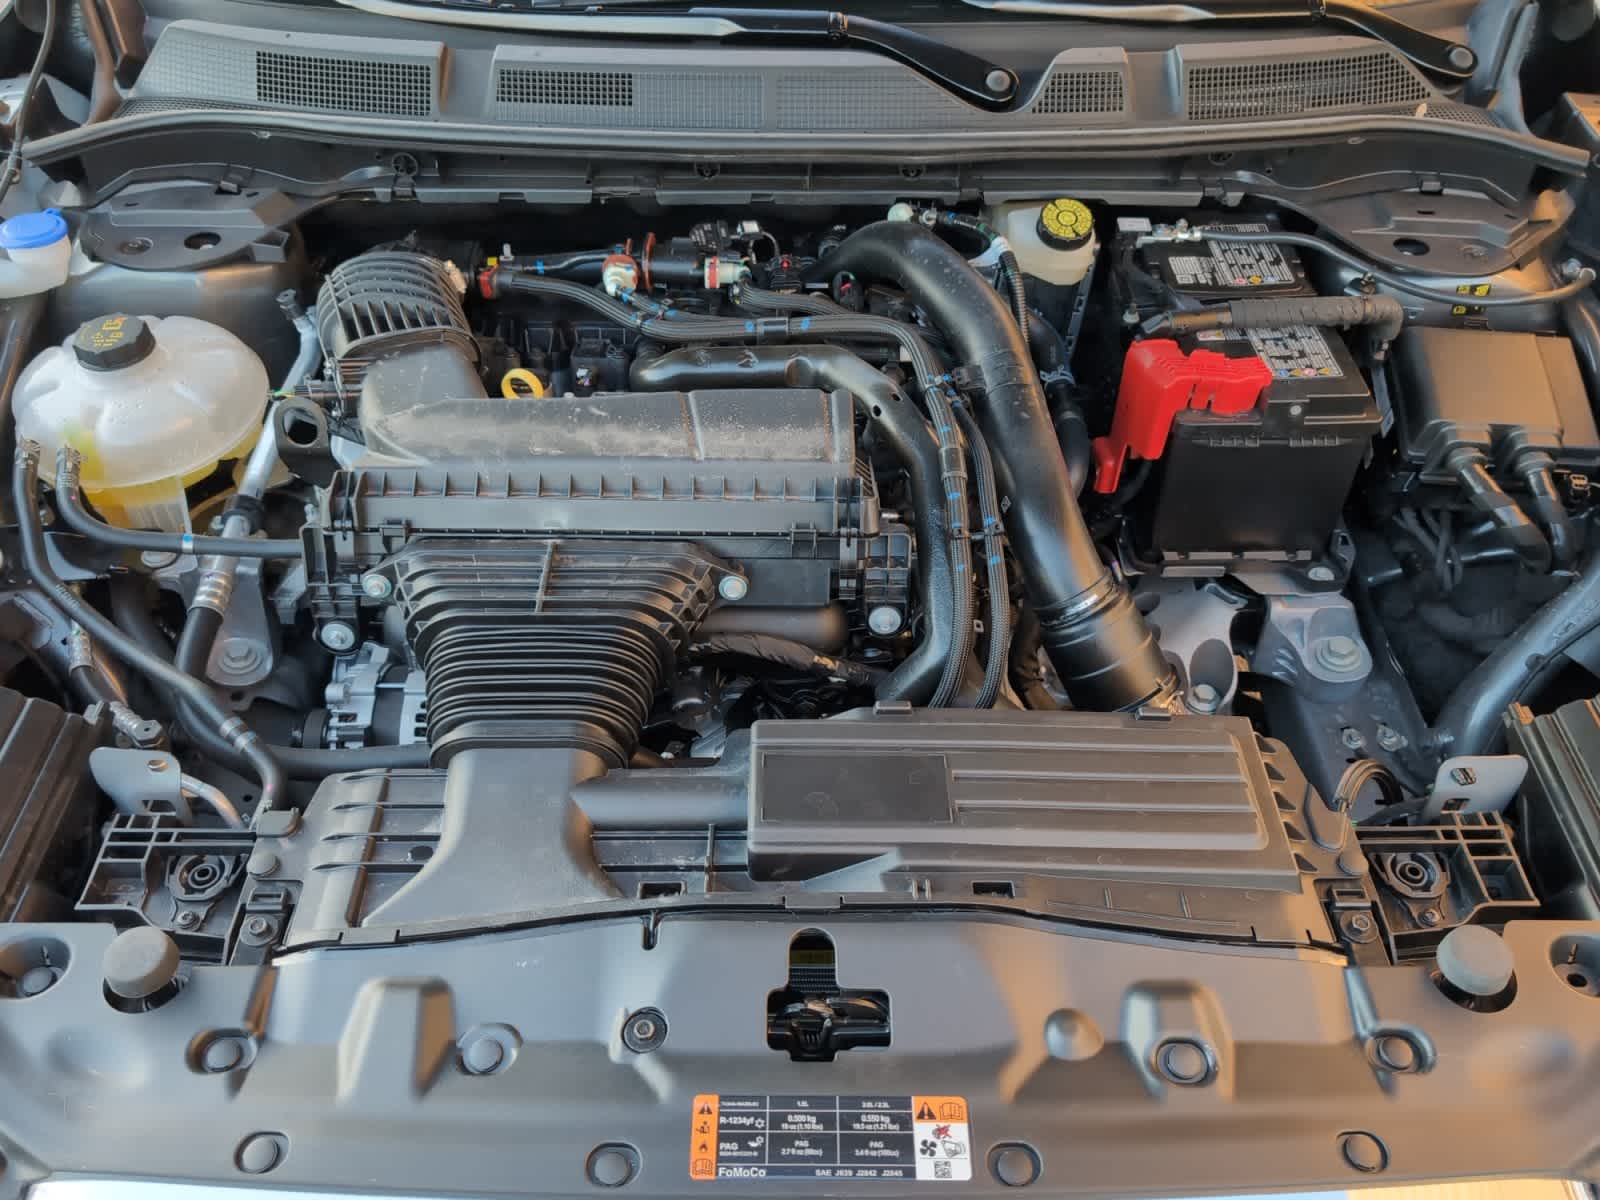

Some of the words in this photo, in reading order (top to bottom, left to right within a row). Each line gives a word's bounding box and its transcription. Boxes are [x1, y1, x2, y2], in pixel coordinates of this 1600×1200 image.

[719, 1116, 754, 1126] R-1234yf
[807, 1114, 816, 1124] kg
[881, 1114, 890, 1124] kg
[719, 1142, 738, 1150] PAG
[718, 1167, 766, 1177] FoMoCo
